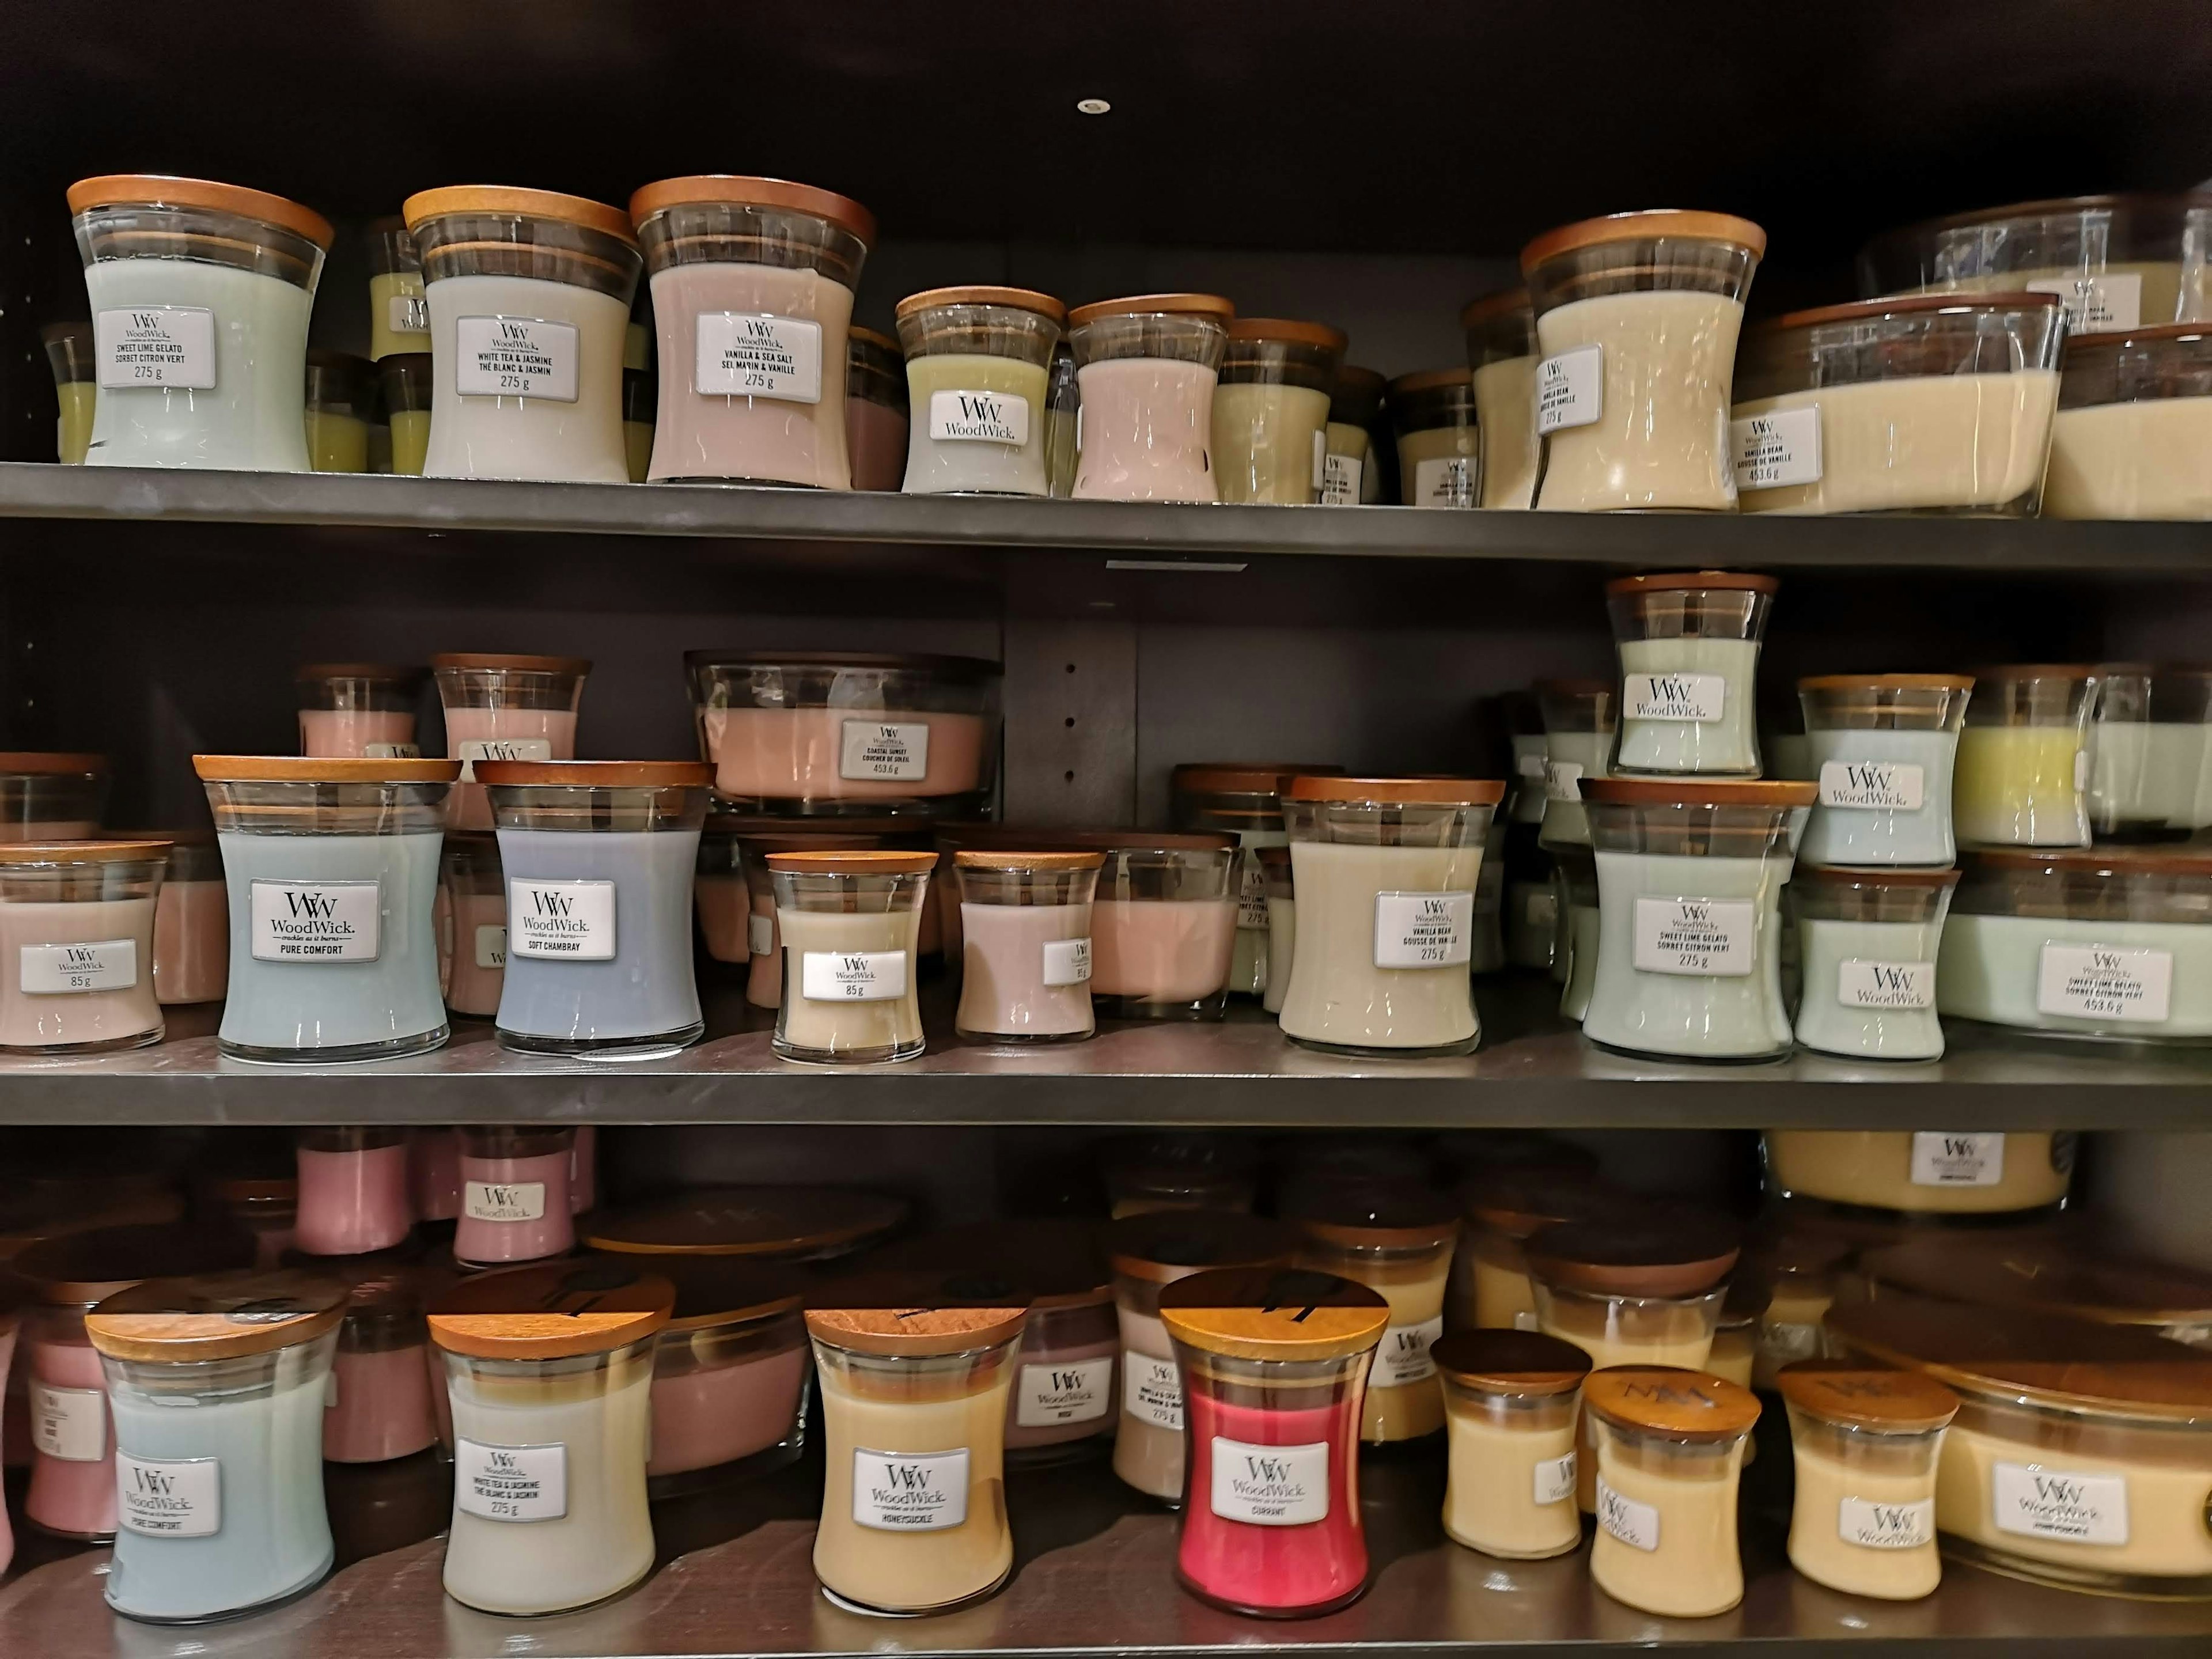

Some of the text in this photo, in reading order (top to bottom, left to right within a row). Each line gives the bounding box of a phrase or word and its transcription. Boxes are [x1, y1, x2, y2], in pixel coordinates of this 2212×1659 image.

[117, 344, 182, 353] SWEET LIME GELATO
[116, 355, 138, 363] SORBET
[166, 355, 185, 363] VERT
[478, 353, 498, 361] WHITE
[501, 354, 513, 362] TEA
[522, 355, 552, 366] JASMINE
[725, 350, 792, 363] VANILLA & SEA SALT
[135, 366, 162, 380] 275 g
[479, 362, 551, 376] THÉ BLANC & JASMIN
[722, 361, 734, 369] SEL
[736, 361, 759, 370] MARIN
[768, 364, 795, 375] VANILLE
[501, 376, 529, 391] 275 g
[745, 374, 774, 390] 275 g
[1744, 448, 1766, 458] VANILLA
[1759, 457, 1767, 465] DE
[1768, 453, 1791, 464] VANILLE
[1749, 467, 1772, 482] 453.6
[873, 764, 893, 773] 453.6
[1413, 927, 1451, 935] VANILLA BEAN
[1660, 931, 1728, 943] SWEET LIME GELATO
[528, 941, 580, 952] SOFT CHAMBRAY
[1403, 937, 1427, 945] GOUSSE
[1429, 937, 1435, 945] DE
[1657, 941, 1729, 953] SORBET CITRON VERT
[281, 945, 343, 955] PURE COMFORT
[1421, 948, 1444, 961] 275 g
[1679, 953, 1698, 967] 275
[71, 976, 90, 988] 85 g
[846, 985, 863, 996] 85 g
[491, 1502, 518, 1517] 275 g
[1251, 1506, 1286, 1516] CURRANT
[131, 1517, 182, 1530] PURE COMFORT
[882, 1514, 933, 1524] HONEYSUCKLE
